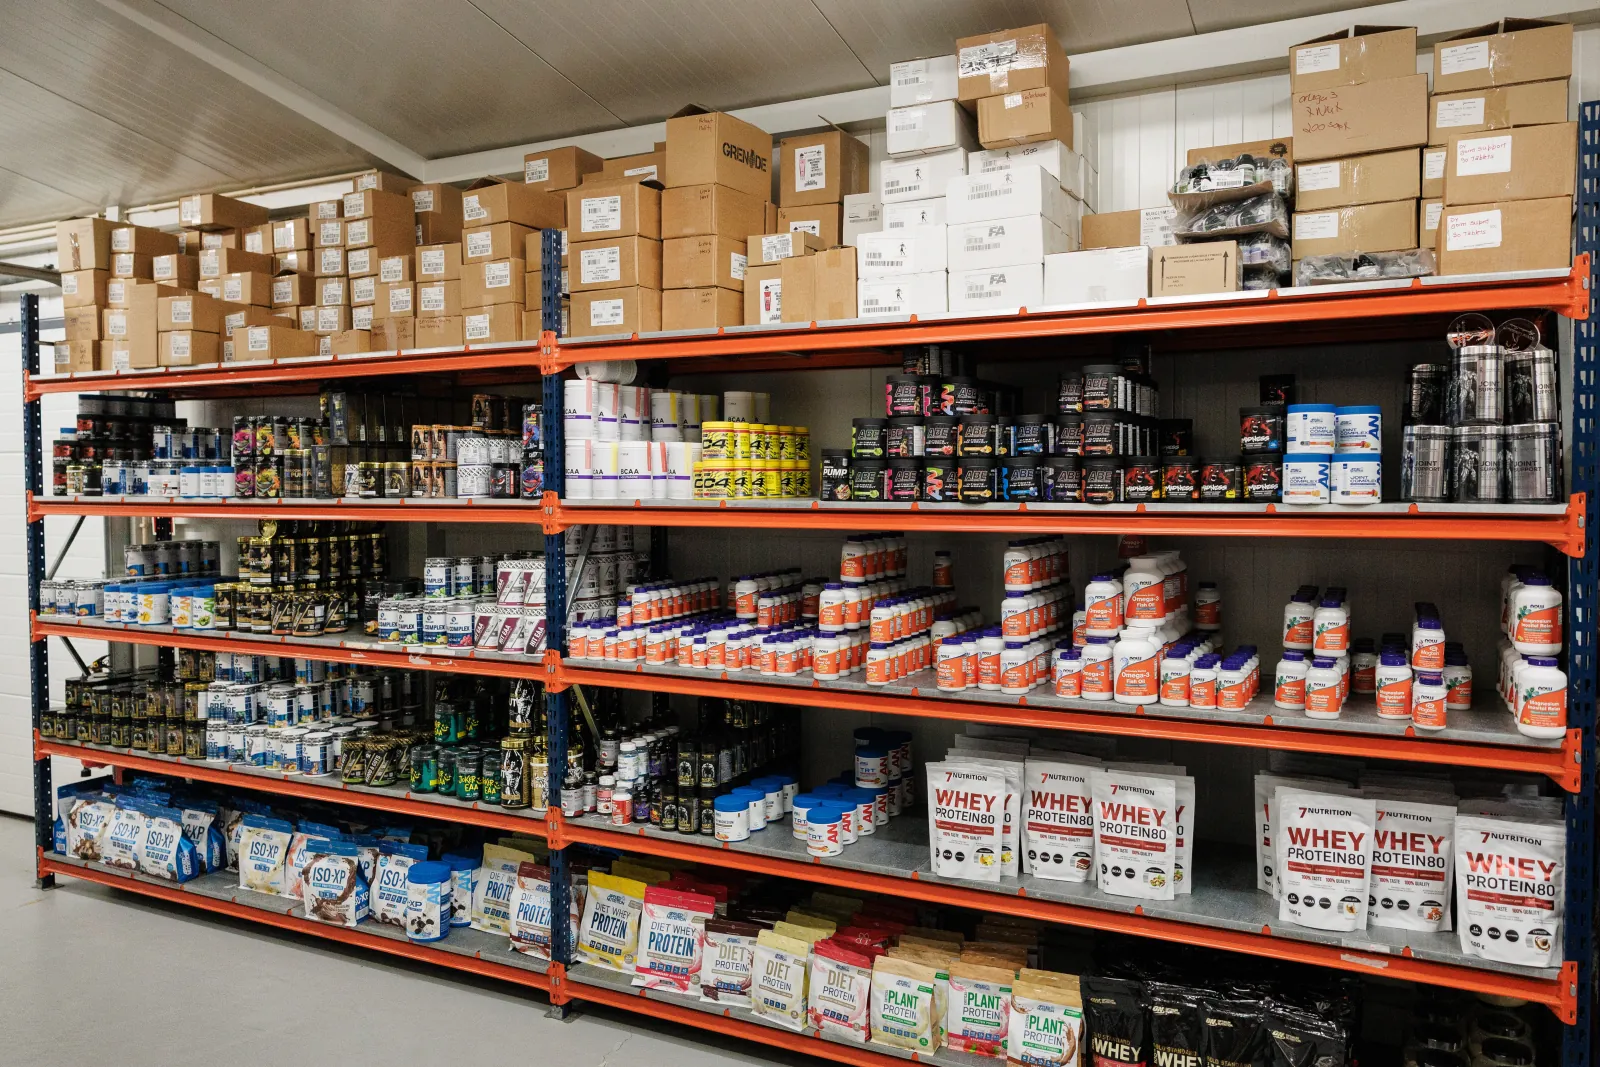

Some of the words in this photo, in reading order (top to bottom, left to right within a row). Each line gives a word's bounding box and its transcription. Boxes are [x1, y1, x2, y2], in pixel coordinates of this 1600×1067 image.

[988, 225, 1006, 237] FA
[989, 273, 1007, 285] FA
[895, 386, 917, 396] ABE
[1085, 378, 1108, 389] ABE
[858, 430, 880, 440] ABE
[965, 426, 988, 437] ABE
[1087, 424, 1110, 434] ABE
[823, 468, 847, 477] PUMP
[855, 472, 876, 482] ABE
[897, 470, 918, 480] ABE
[965, 470, 987, 481] ABE
[1011, 469, 1034, 480] ABE
[1058, 471, 1081, 481] ABE
[1089, 471, 1112, 481] ABE
[458, 775, 476, 784] JOKER
[464, 783, 479, 792] EAA
[877, 794, 887, 814] AN
[935, 788, 996, 812] WHEY
[1031, 790, 1093, 814] WHEY
[862, 804, 873, 824] AN
[935, 807, 995, 825] PROTEIN80
[1028, 810, 1094, 826] PROTEIN80
[1101, 801, 1166, 827] WHEY
[827, 824, 838, 844] AN
[1099, 821, 1166, 840] PROTEIN80
[1287, 826, 1365, 851] WHEY
[1374, 829, 1445, 854] WHEY
[1287, 847, 1365, 866] PROTEIN80
[1373, 851, 1445, 869] ROTEIN80
[1466, 851, 1557, 882] WHEY
[379, 868, 407, 886] ISO-X
[1466, 874, 1555, 897] PROTEIN80
[595, 902, 610, 914] DIET
[612, 907, 631, 920] WHEY
[591, 912, 628, 939] PROTEIN
[651, 921, 671, 932] DIET
[672, 925, 697, 937] WHEY
[648, 931, 695, 957] PROTEIN
[718, 943, 745, 962] DIET
[715, 960, 748, 972] PROTEIN
[765, 959, 791, 981] DIET
[762, 976, 792, 992] PROTEIN
[827, 969, 856, 991] DIET
[822, 985, 855, 1003] PROTEIN
[888, 989, 919, 1010] PLANT
[967, 991, 1001, 1010] PLANT
[883, 1003, 917, 1020] PROTEIN
[963, 1006, 1001, 1020] PROTEIN
[1029, 1014, 1065, 1036] PLANT
[1023, 1030, 1063, 1047] PROTEIN
[1093, 1037, 1141, 1062] WHEY
[1156, 1050, 1202, 1067] WHE
